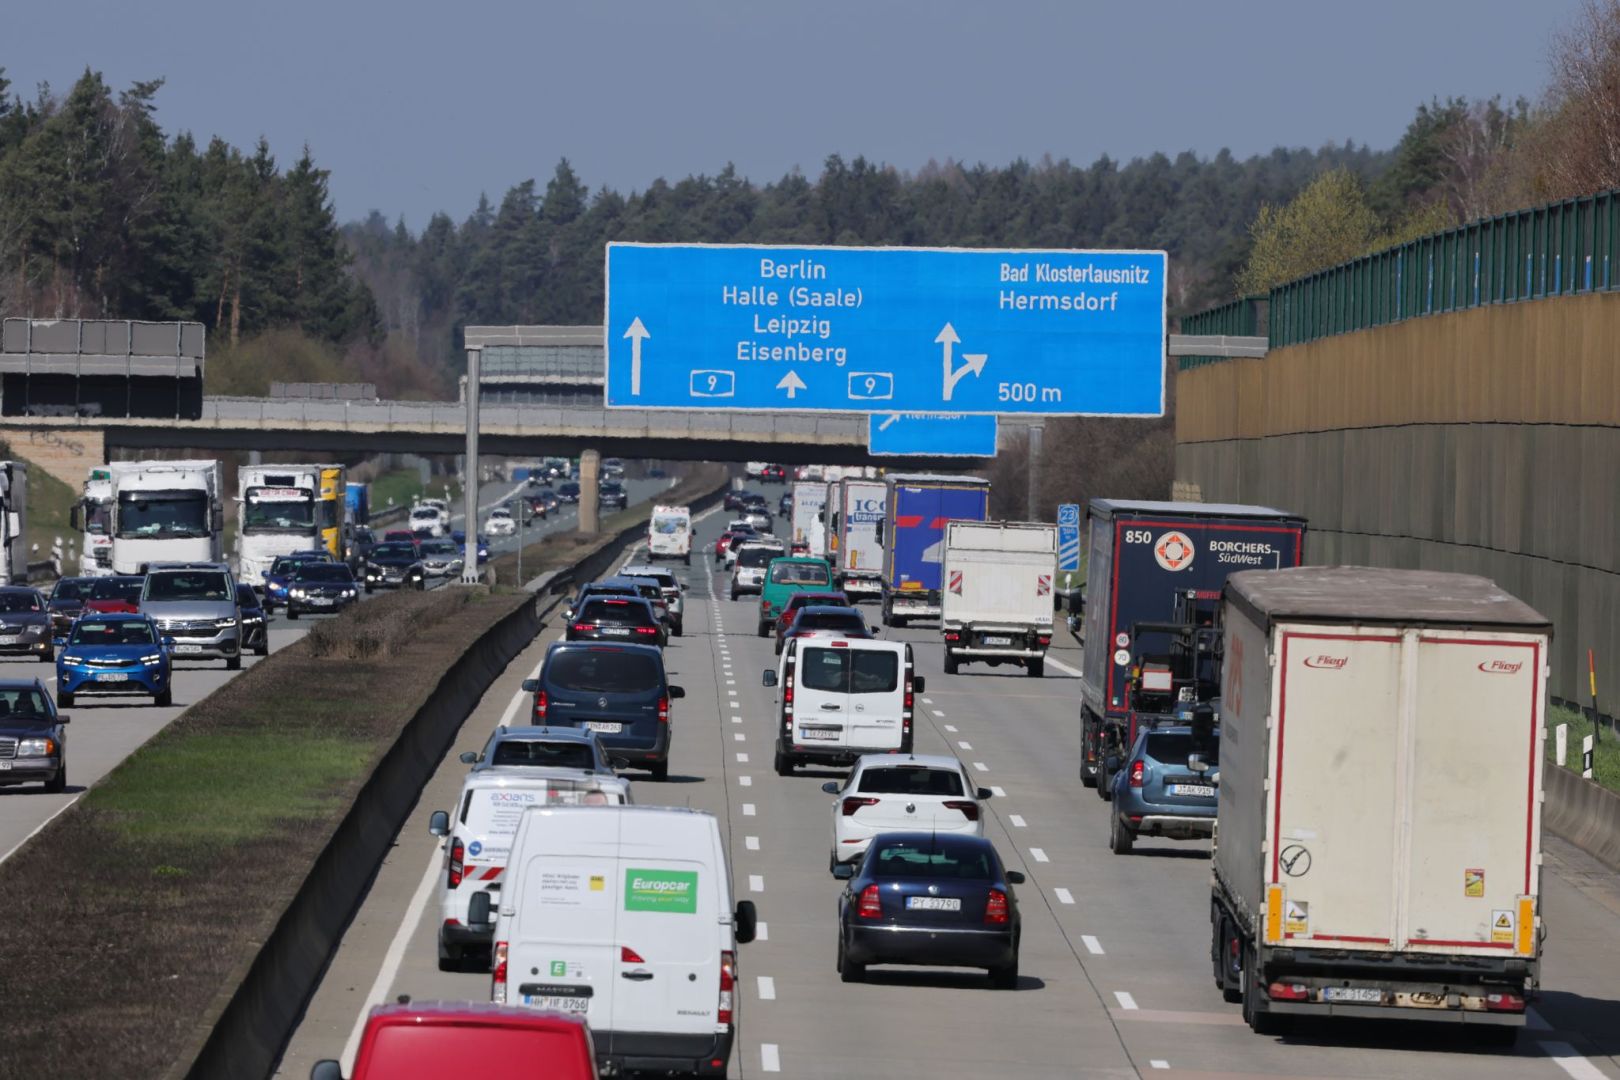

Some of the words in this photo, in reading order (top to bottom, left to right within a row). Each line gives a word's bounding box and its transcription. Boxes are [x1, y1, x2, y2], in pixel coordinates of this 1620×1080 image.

[760, 259, 827, 280] Berlin
[1000, 263, 1029, 283] Bad
[1036, 263, 1150, 285] Klosterlausnitz
[723, 287, 778, 306] Halle
[789, 287, 864, 308] (Saale)
[999, 290, 1119, 312] Hermsdorf
[754, 314, 831, 339] Leipzig
[737, 341, 847, 367] Eisenberg
[707, 375, 717, 391] 9
[865, 377, 877, 394] 9
[998, 383, 1036, 402] 500
[1041, 387, 1062, 402] m
[1063, 511, 1075, 520] 23
[1125, 530, 1152, 545] 850
[1209, 540, 1271, 555] BORCHERS
[1217, 551, 1263, 565] SüdWest
[1316, 655, 1349, 668] Fliegl
[1491, 660, 1523, 672] Fliegl
[632, 877, 691, 893] Europcar
